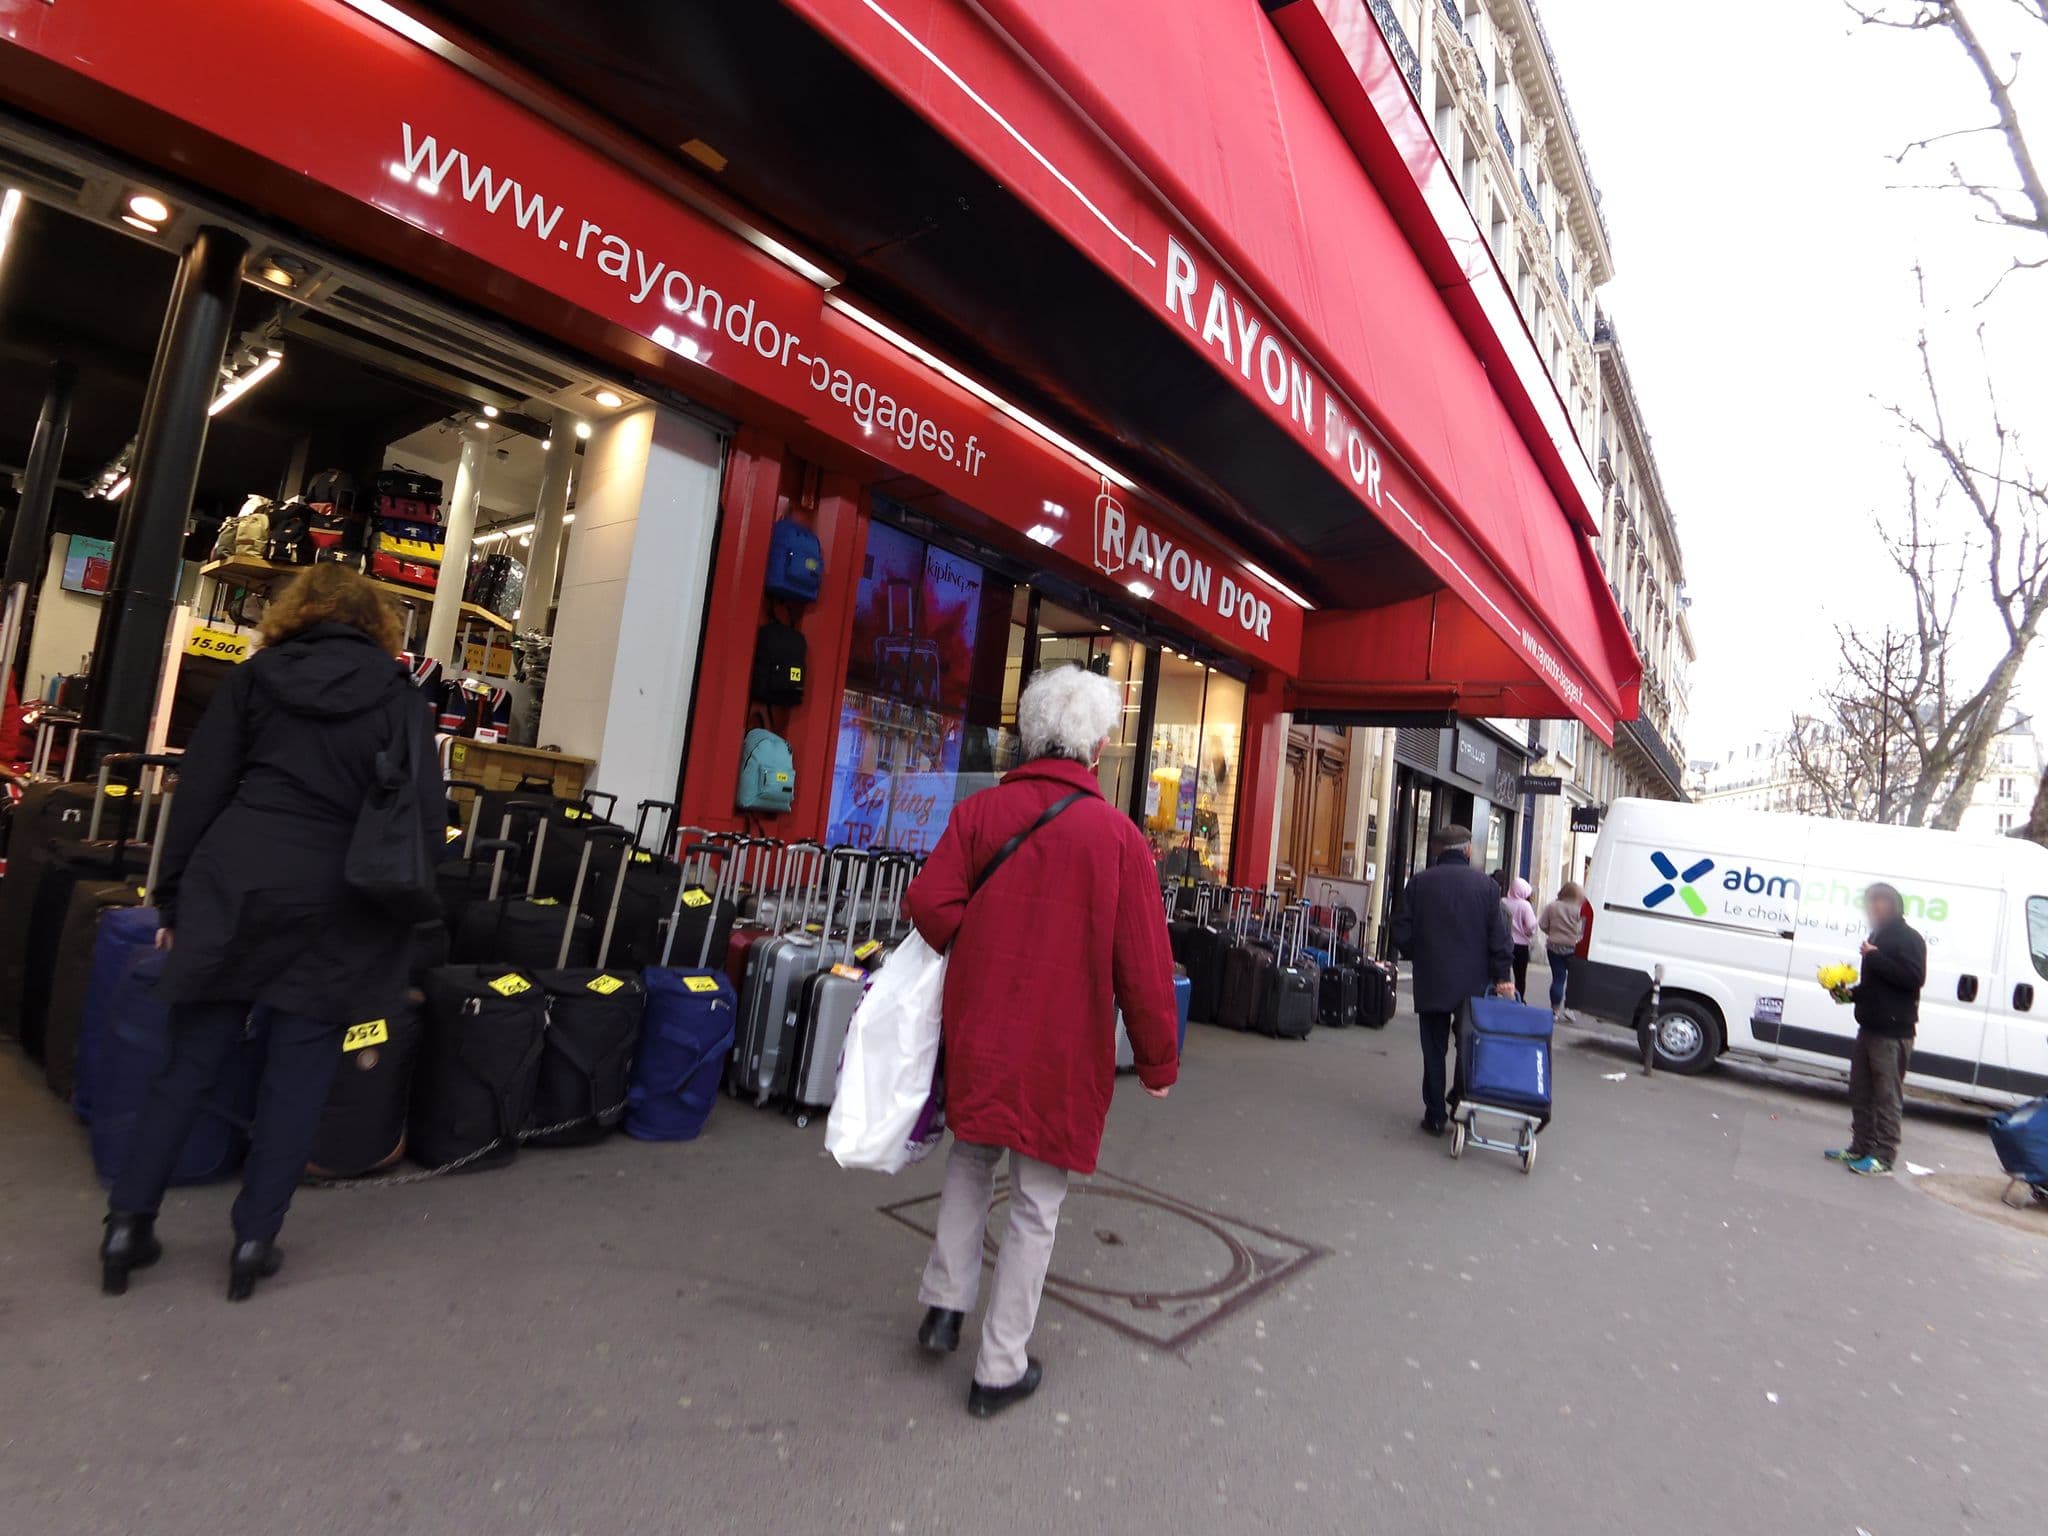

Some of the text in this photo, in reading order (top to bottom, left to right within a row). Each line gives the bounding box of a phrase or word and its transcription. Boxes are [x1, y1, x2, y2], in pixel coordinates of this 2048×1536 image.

[1165, 234, 1313, 436] RAYON
[1102, 504, 1272, 642] RAYON D'OR
[191, 636, 246, 656] 15.90€
[1460, 739, 1487, 765] CYRILLUS
[1523, 777, 1558, 788] CYRILLUS
[1572, 821, 1597, 833] éram
[1724, 900, 1743, 915] Le
[1747, 903, 1791, 923] choix
